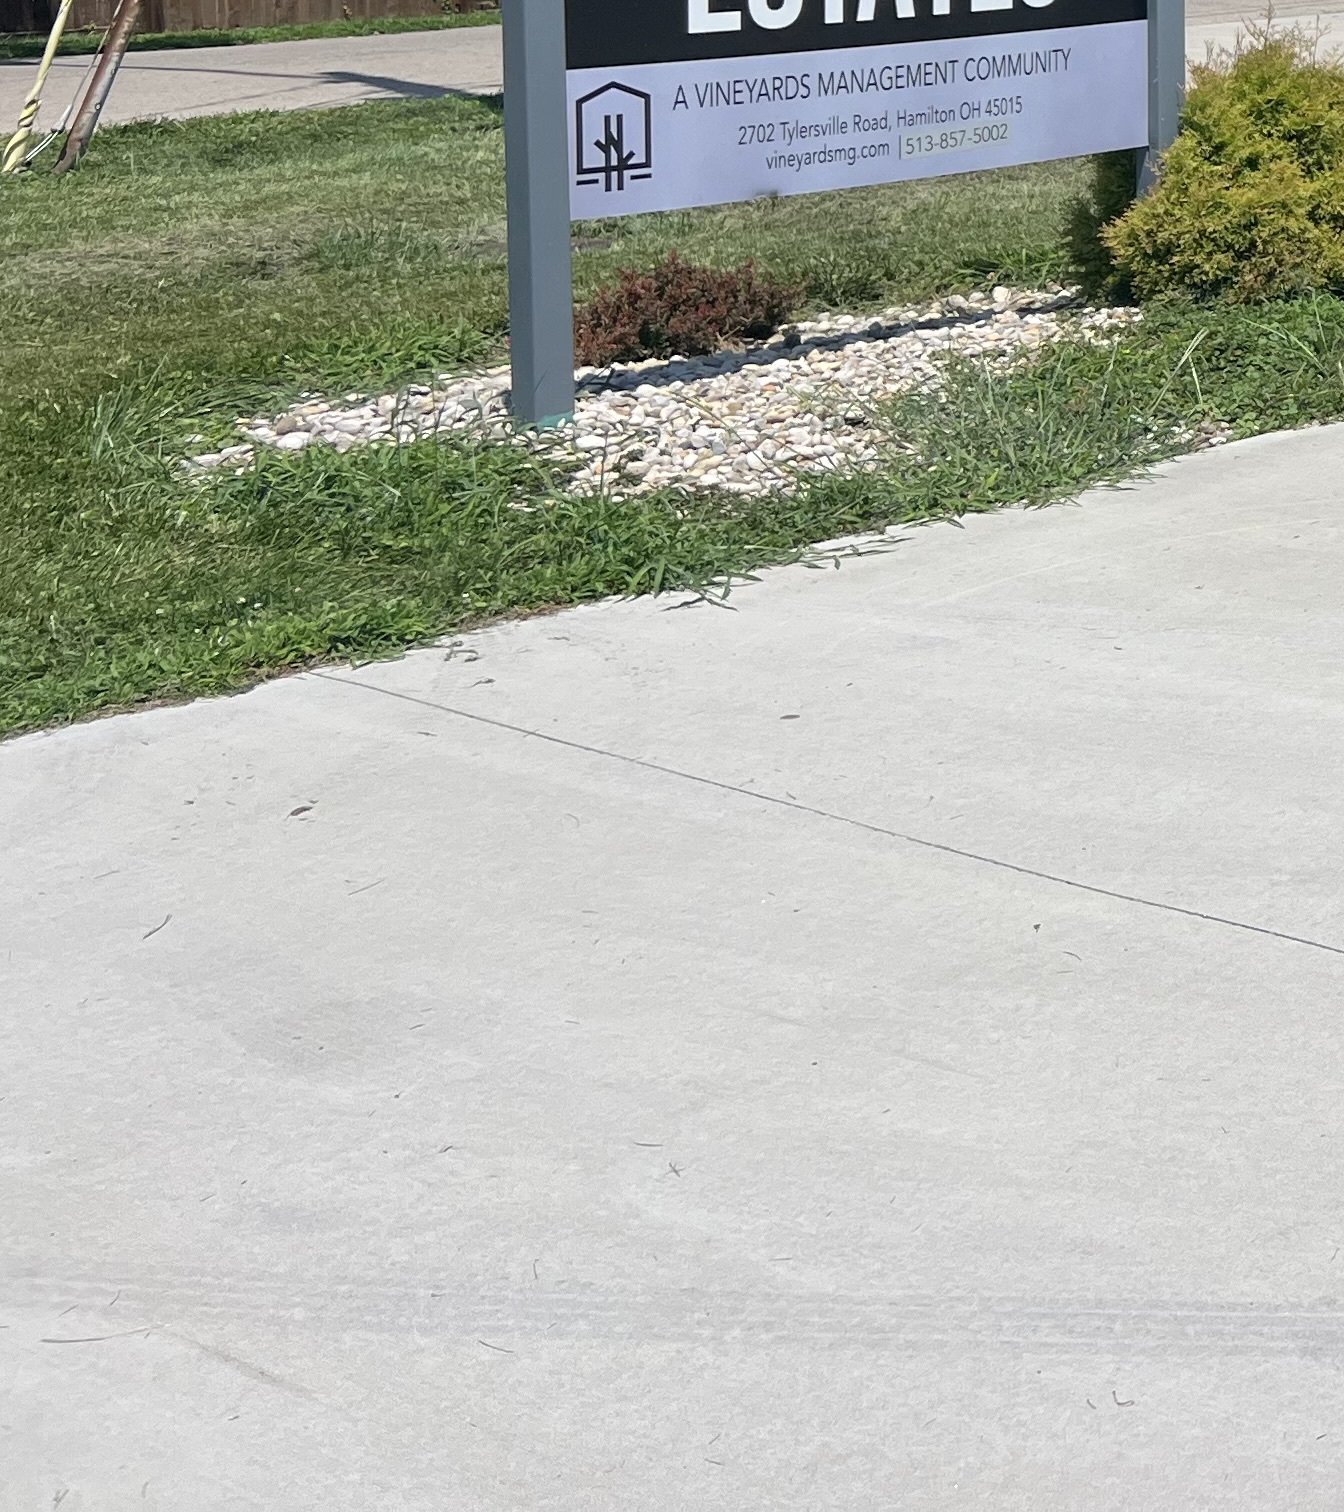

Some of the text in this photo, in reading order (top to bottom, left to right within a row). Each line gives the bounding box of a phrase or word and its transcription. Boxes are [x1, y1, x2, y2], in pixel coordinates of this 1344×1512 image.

[672, 47, 1072, 111] A VINEYARDS MANAGEMENT COMMUNITY
[738, 95, 1023, 147] 2702 Tylersville Road, Hamilton OH 45015
[765, 140, 890, 173] vineyardsmg.com
[905, 123, 1009, 156] 513-857-5002
